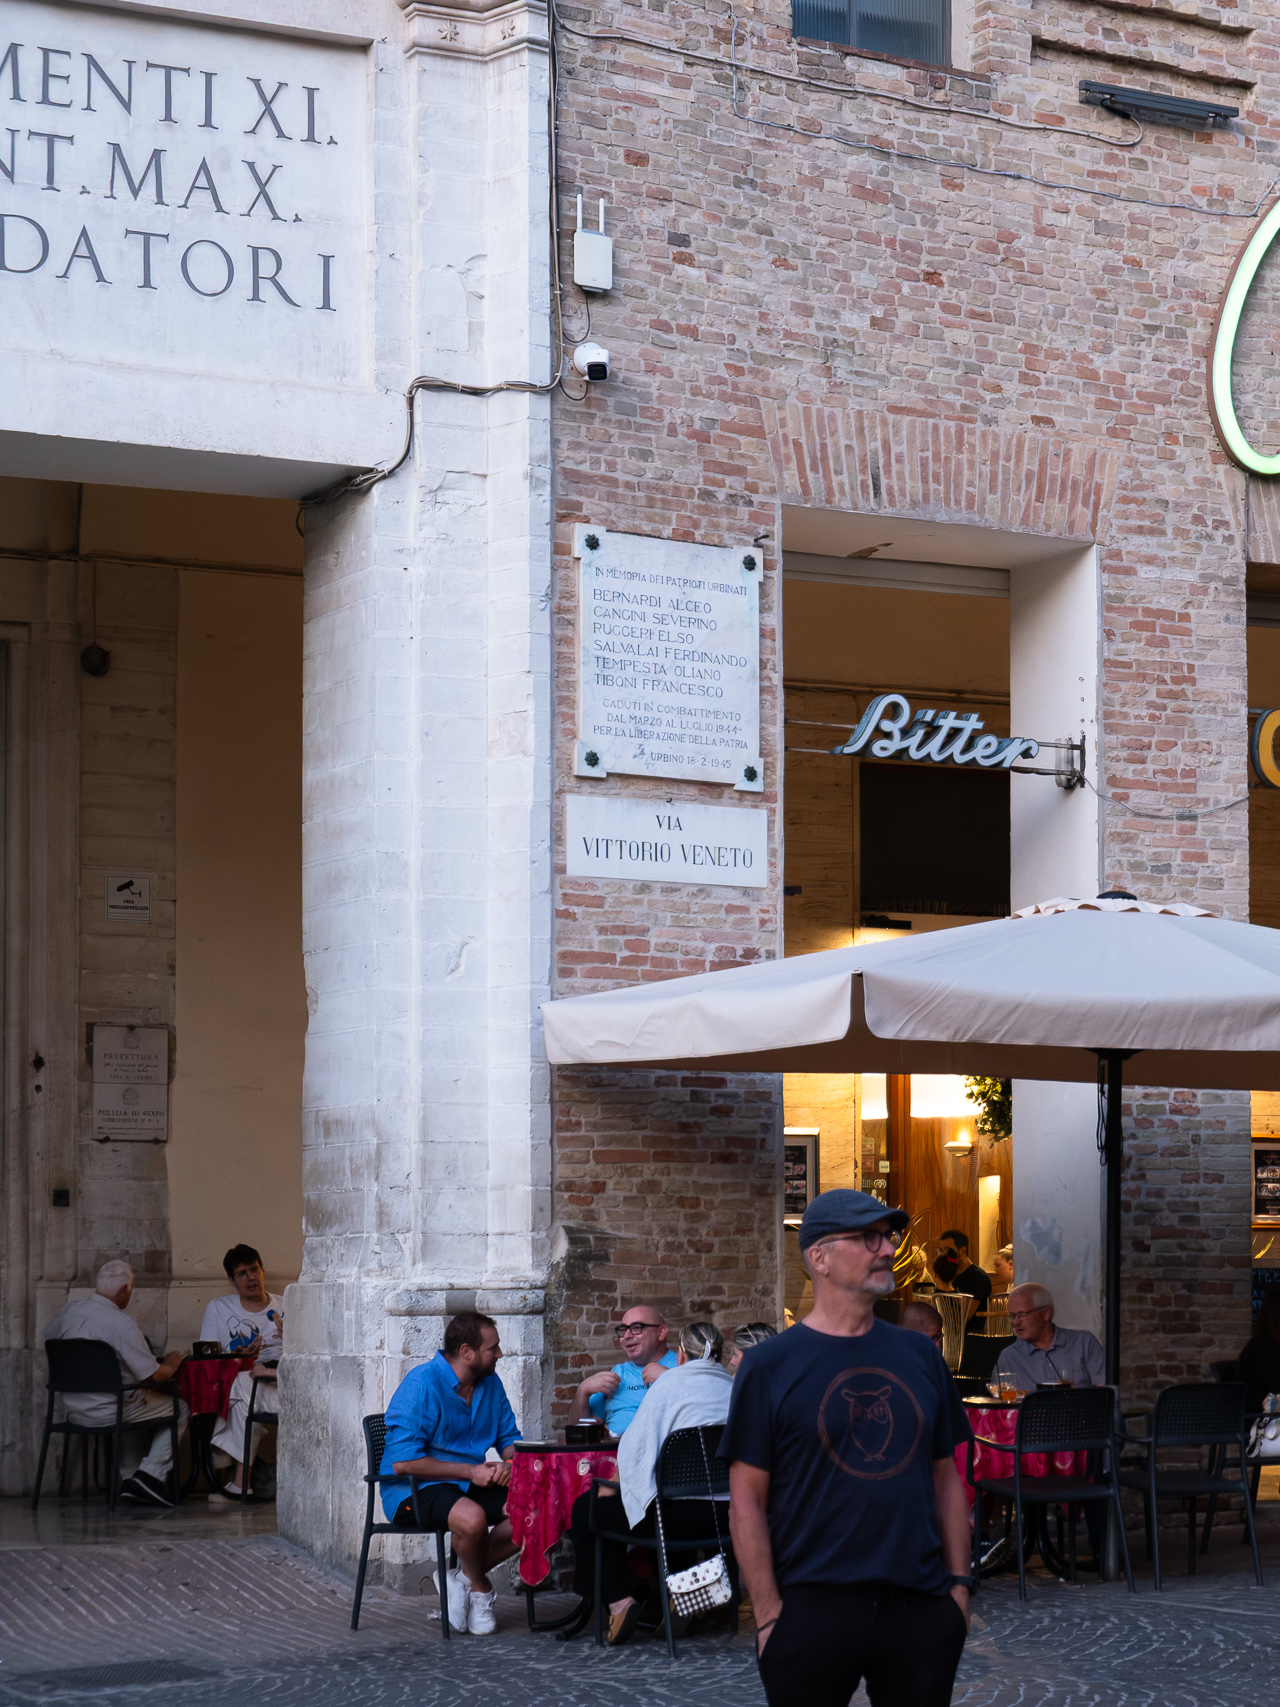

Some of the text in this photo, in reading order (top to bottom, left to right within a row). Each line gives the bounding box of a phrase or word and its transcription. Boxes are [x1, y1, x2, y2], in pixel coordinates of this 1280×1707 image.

[0, 213, 337, 311] DATORI
[595, 567, 747, 596] IN MEMORIA DEI PATRIOTI URBINATI
[593, 589, 712, 614] BERNARDI ALCEO
[593, 606, 717, 631] CANGINI SEVERINO
[593, 622, 694, 645] RUGGERI ELSO
[593, 639, 747, 668] SALVALAI FERDINANDO
[594, 656, 721, 681] TEMPESTA OLIANO
[594, 673, 724, 698] TIBONI FRANCESCO
[602, 698, 741, 722] CADUTI IN COMBATTIMENTO
[606, 713, 626, 724] DAL
[629, 715, 662, 727] MARZO
[665, 719, 677, 729] AL
[680, 720, 713, 732] LUGLIO
[593, 725, 749, 750] PER LA LIBERAZIONE DELLA PATRIA
[833, 693, 1040, 769] Bitter
[650, 752, 684, 764] URBINO
[655, 814, 683, 831] VIA
[582, 836, 753, 869] VITTORIO VENETO
